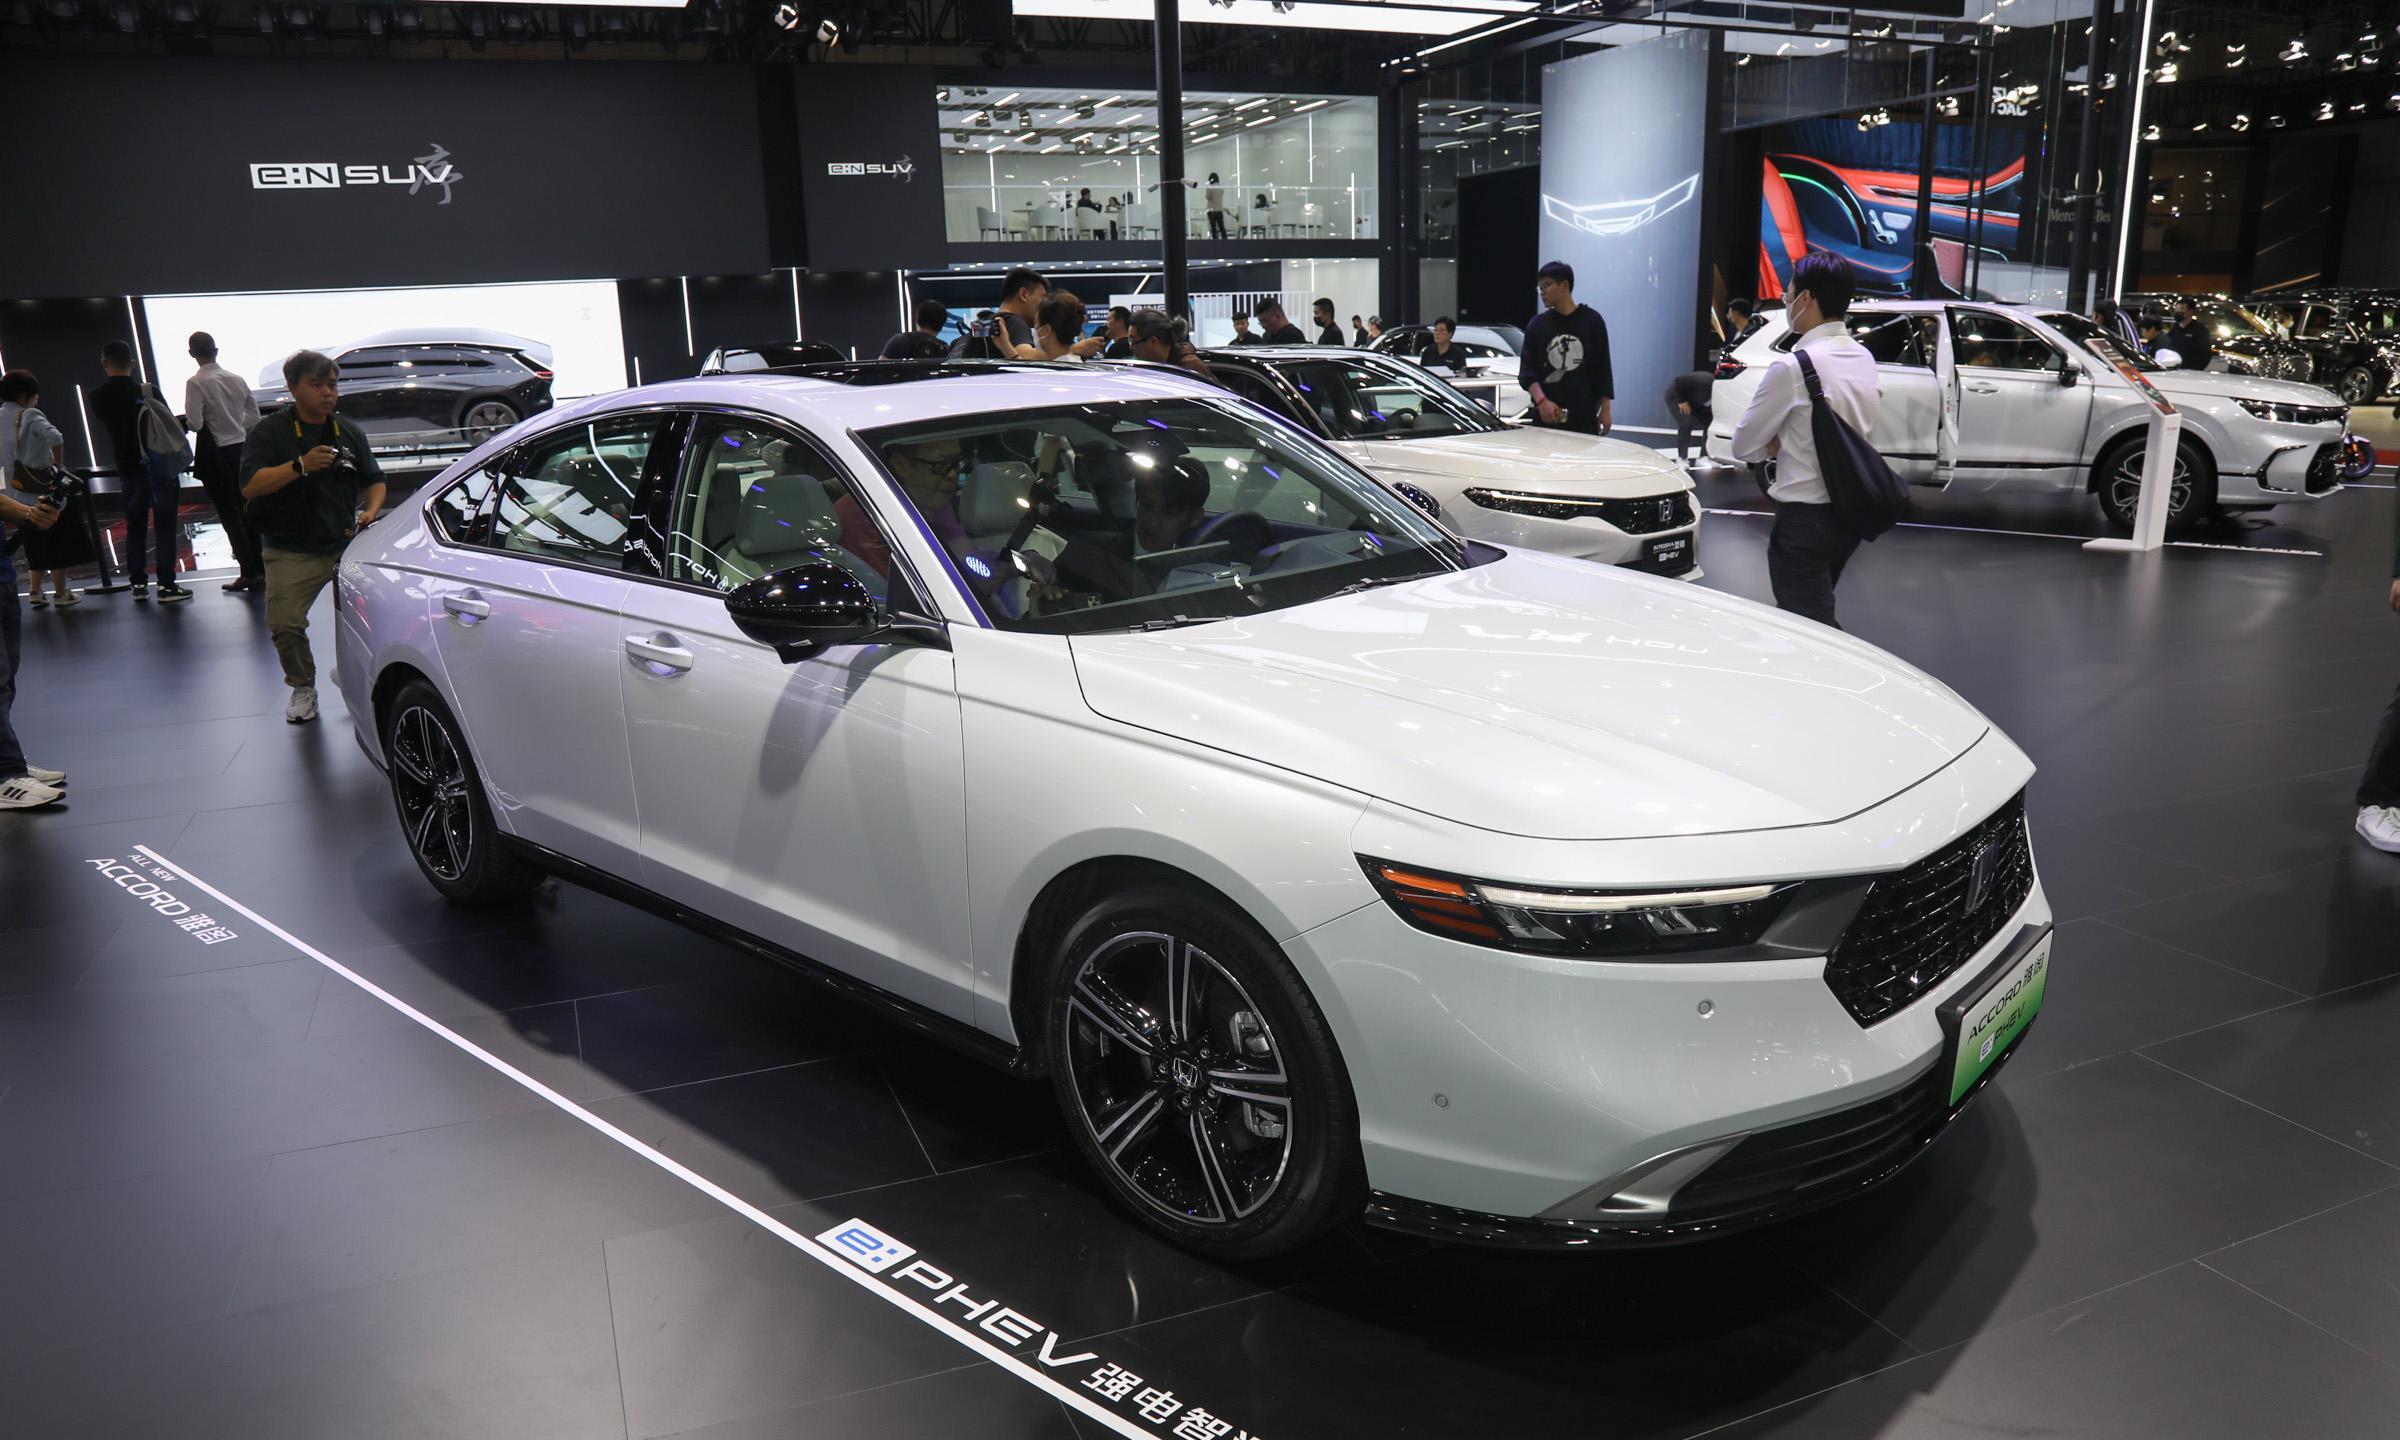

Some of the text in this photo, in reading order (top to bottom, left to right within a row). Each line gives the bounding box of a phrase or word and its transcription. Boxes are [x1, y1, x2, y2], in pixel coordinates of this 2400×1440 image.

[344, 164, 453, 185] SUV
[866, 163, 913, 174] SUV
[127, 853, 178, 882] ALL NEW
[85, 858, 239, 945] ACCORD 雅阁
[1967, 980, 2022, 1045] ACCORD
[1080, 1362, 1264, 1440] 强电智
